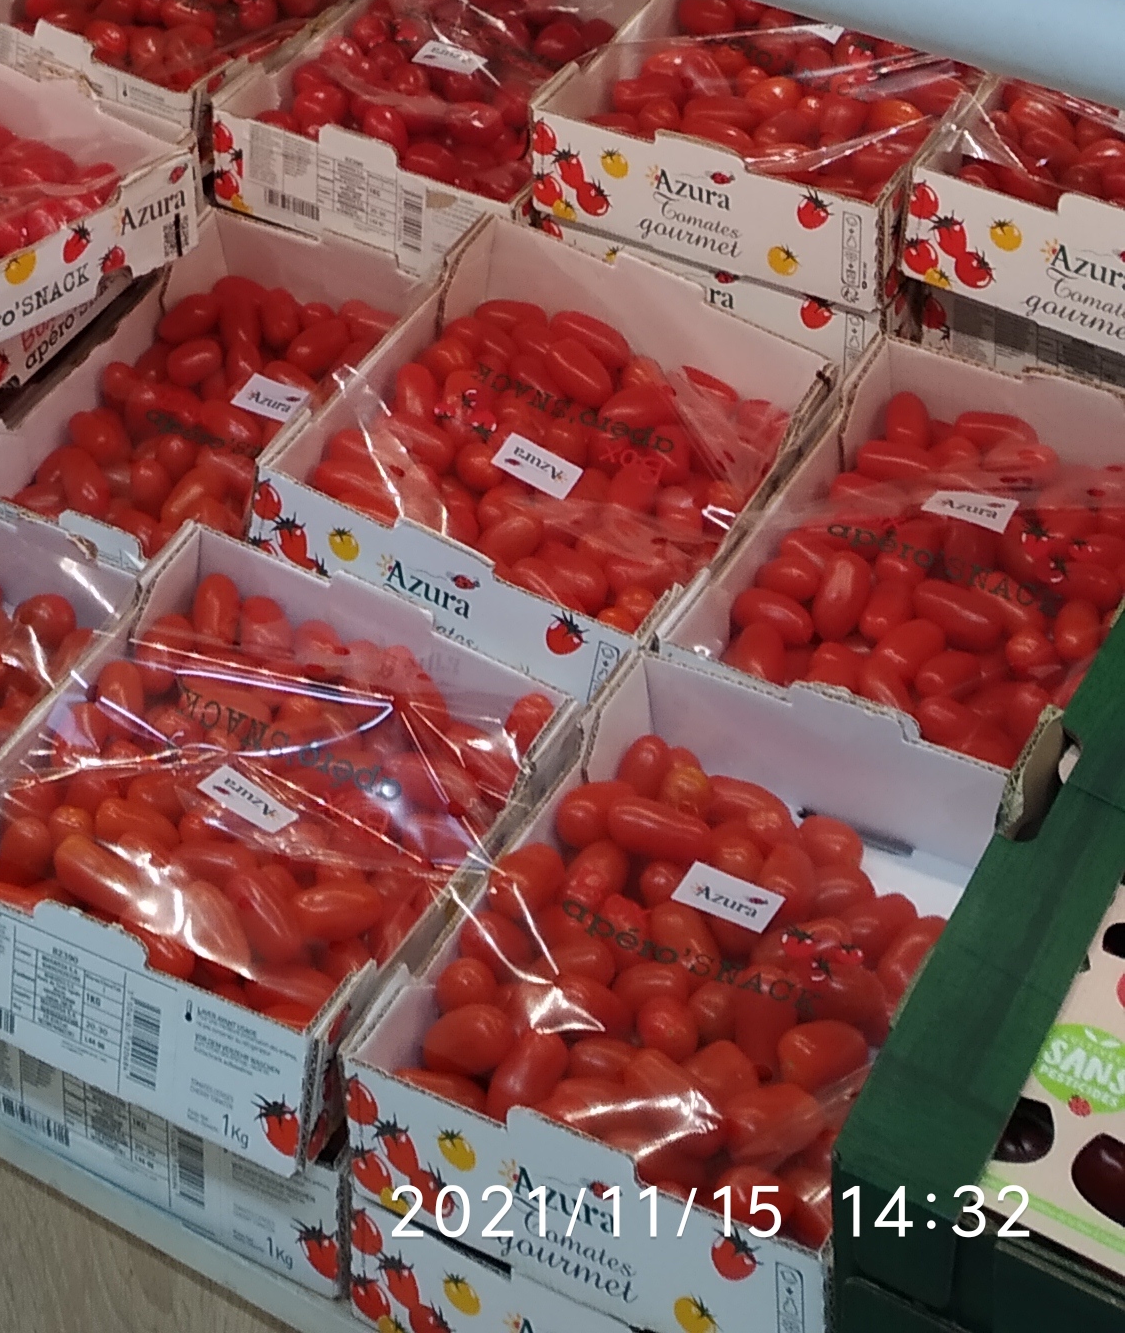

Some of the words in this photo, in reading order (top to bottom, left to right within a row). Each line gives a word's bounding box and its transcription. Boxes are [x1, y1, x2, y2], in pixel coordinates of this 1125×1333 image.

[655, 169, 731, 211] Azura
[120, 189, 186, 235] Azura
[653, 191, 742, 239] Tomates
[636, 218, 743, 259] gourmet
[251, 389, 293, 414] Azura
[513, 445, 563, 481] Azura
[942, 497, 998, 520] Azura
[386, 560, 471, 620] Azura
[223, 776, 278, 817] Azura
[696, 884, 758, 919] Azura
[1043, 1039, 1125, 1096] SANS
